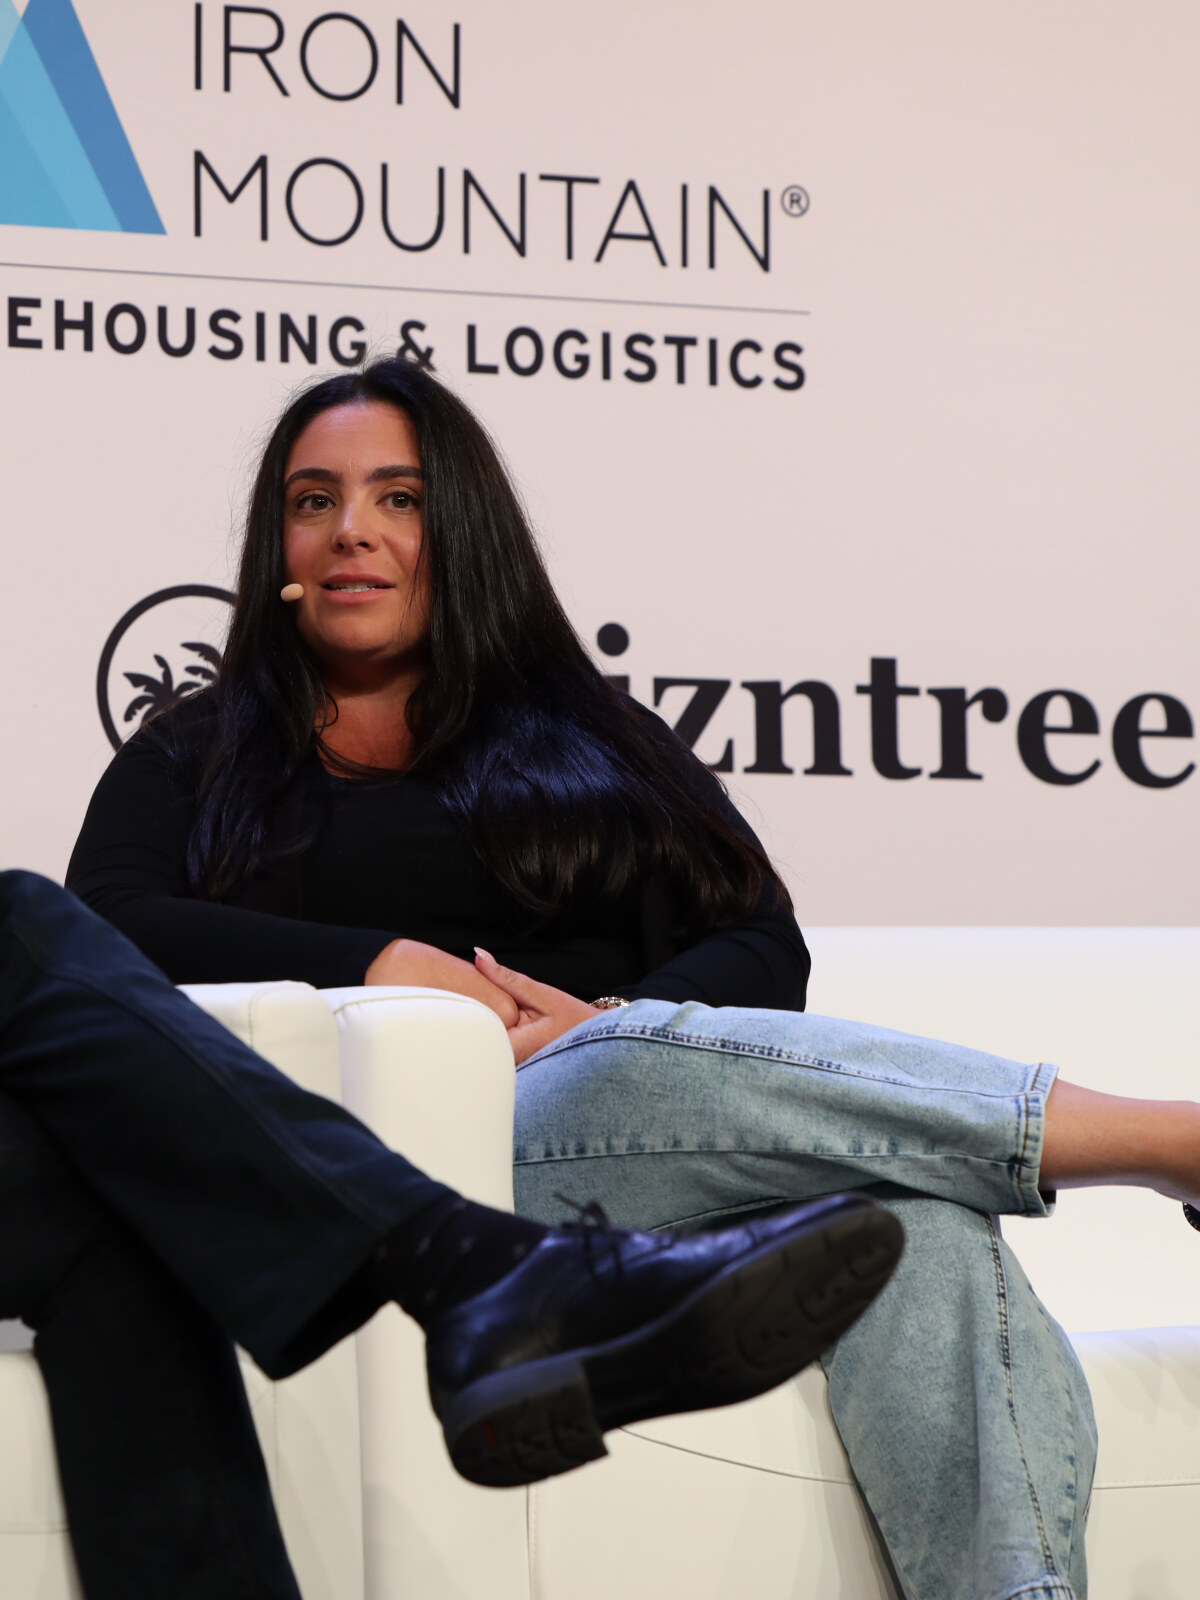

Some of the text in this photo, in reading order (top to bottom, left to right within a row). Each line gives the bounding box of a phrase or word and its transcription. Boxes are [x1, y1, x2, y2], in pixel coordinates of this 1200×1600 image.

[194, 2, 461, 110] IRON
[397, 320, 435, 371] &
[467, 324, 806, 391] LOGISTICS
